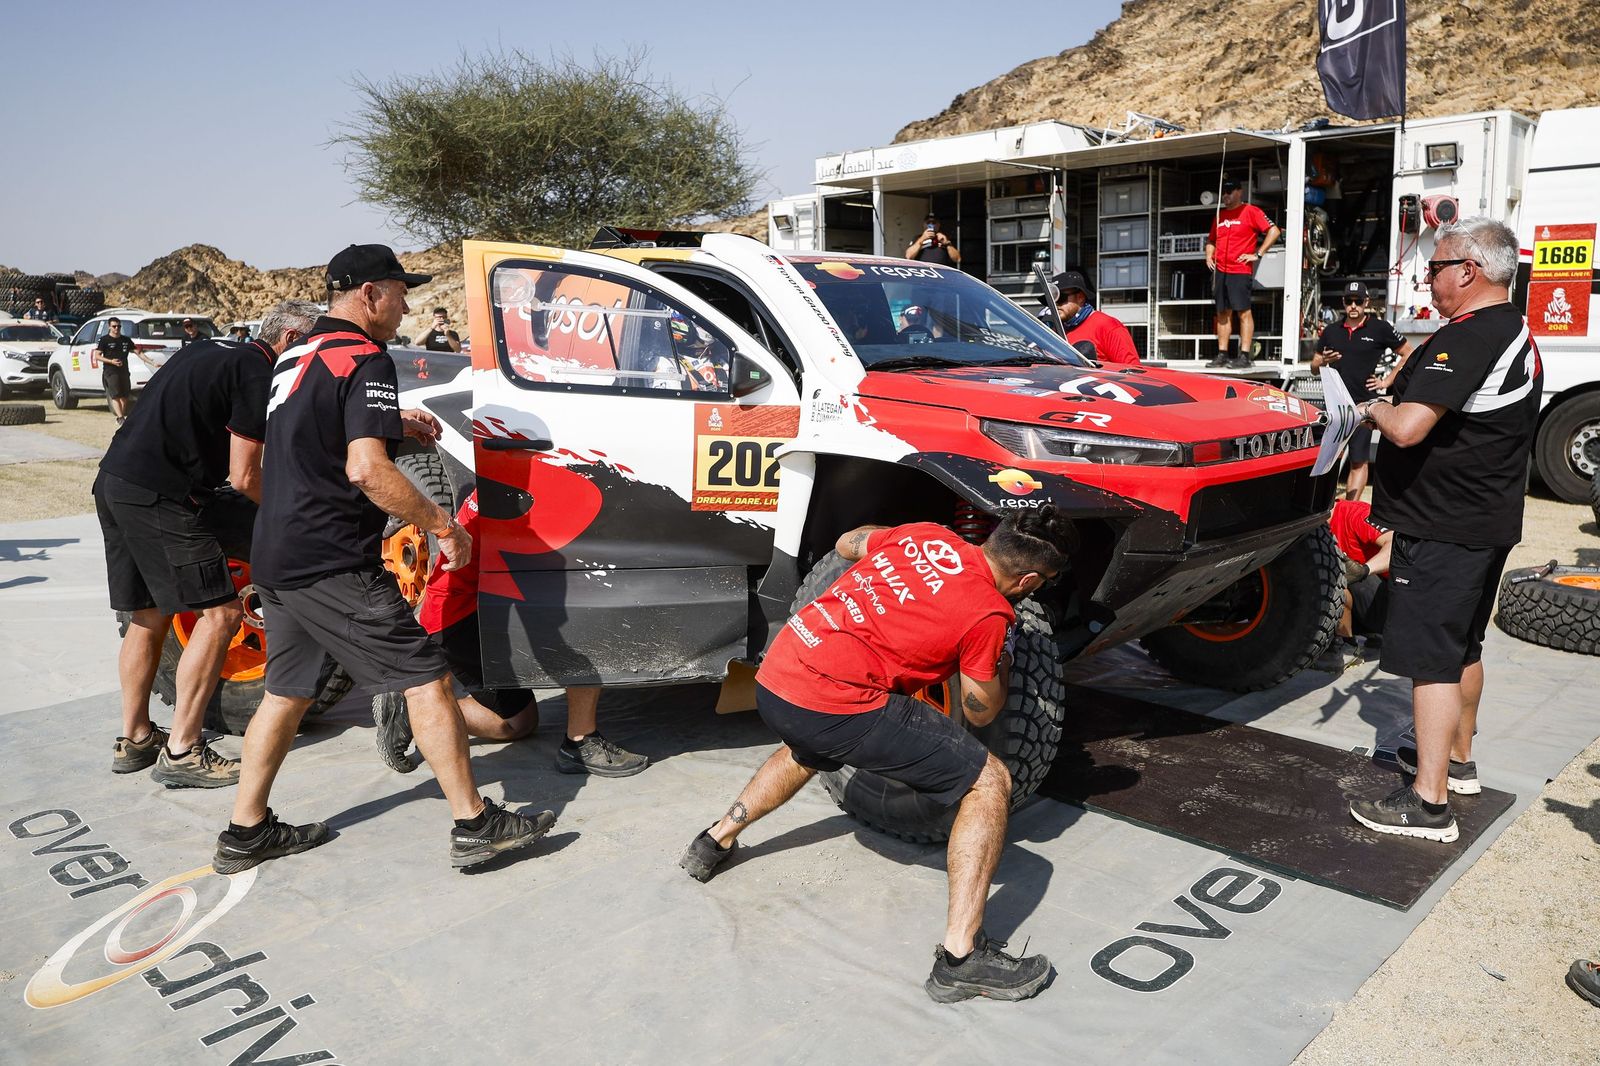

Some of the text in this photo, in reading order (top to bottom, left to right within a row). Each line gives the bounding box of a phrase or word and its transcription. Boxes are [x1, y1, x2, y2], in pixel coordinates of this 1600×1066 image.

[1539, 246, 1587, 265] 1686
[870, 266, 944, 279] repsol
[1543, 311, 1574, 325] DAKAR
[1548, 324, 1569, 332] 2026
[365, 381, 395, 389] HILUX
[1038, 411, 1112, 428] GR
[1235, 426, 1315, 461] TOYOTA
[708, 440, 784, 487] 202
[696, 496, 778, 506] DREAM. DARE. LIV
[999, 497, 1052, 509] reps
[898, 536, 944, 595] TOYOTA
[7, 809, 151, 900] over
[1089, 857, 1298, 992] ove
[140, 941, 344, 1066] driv
